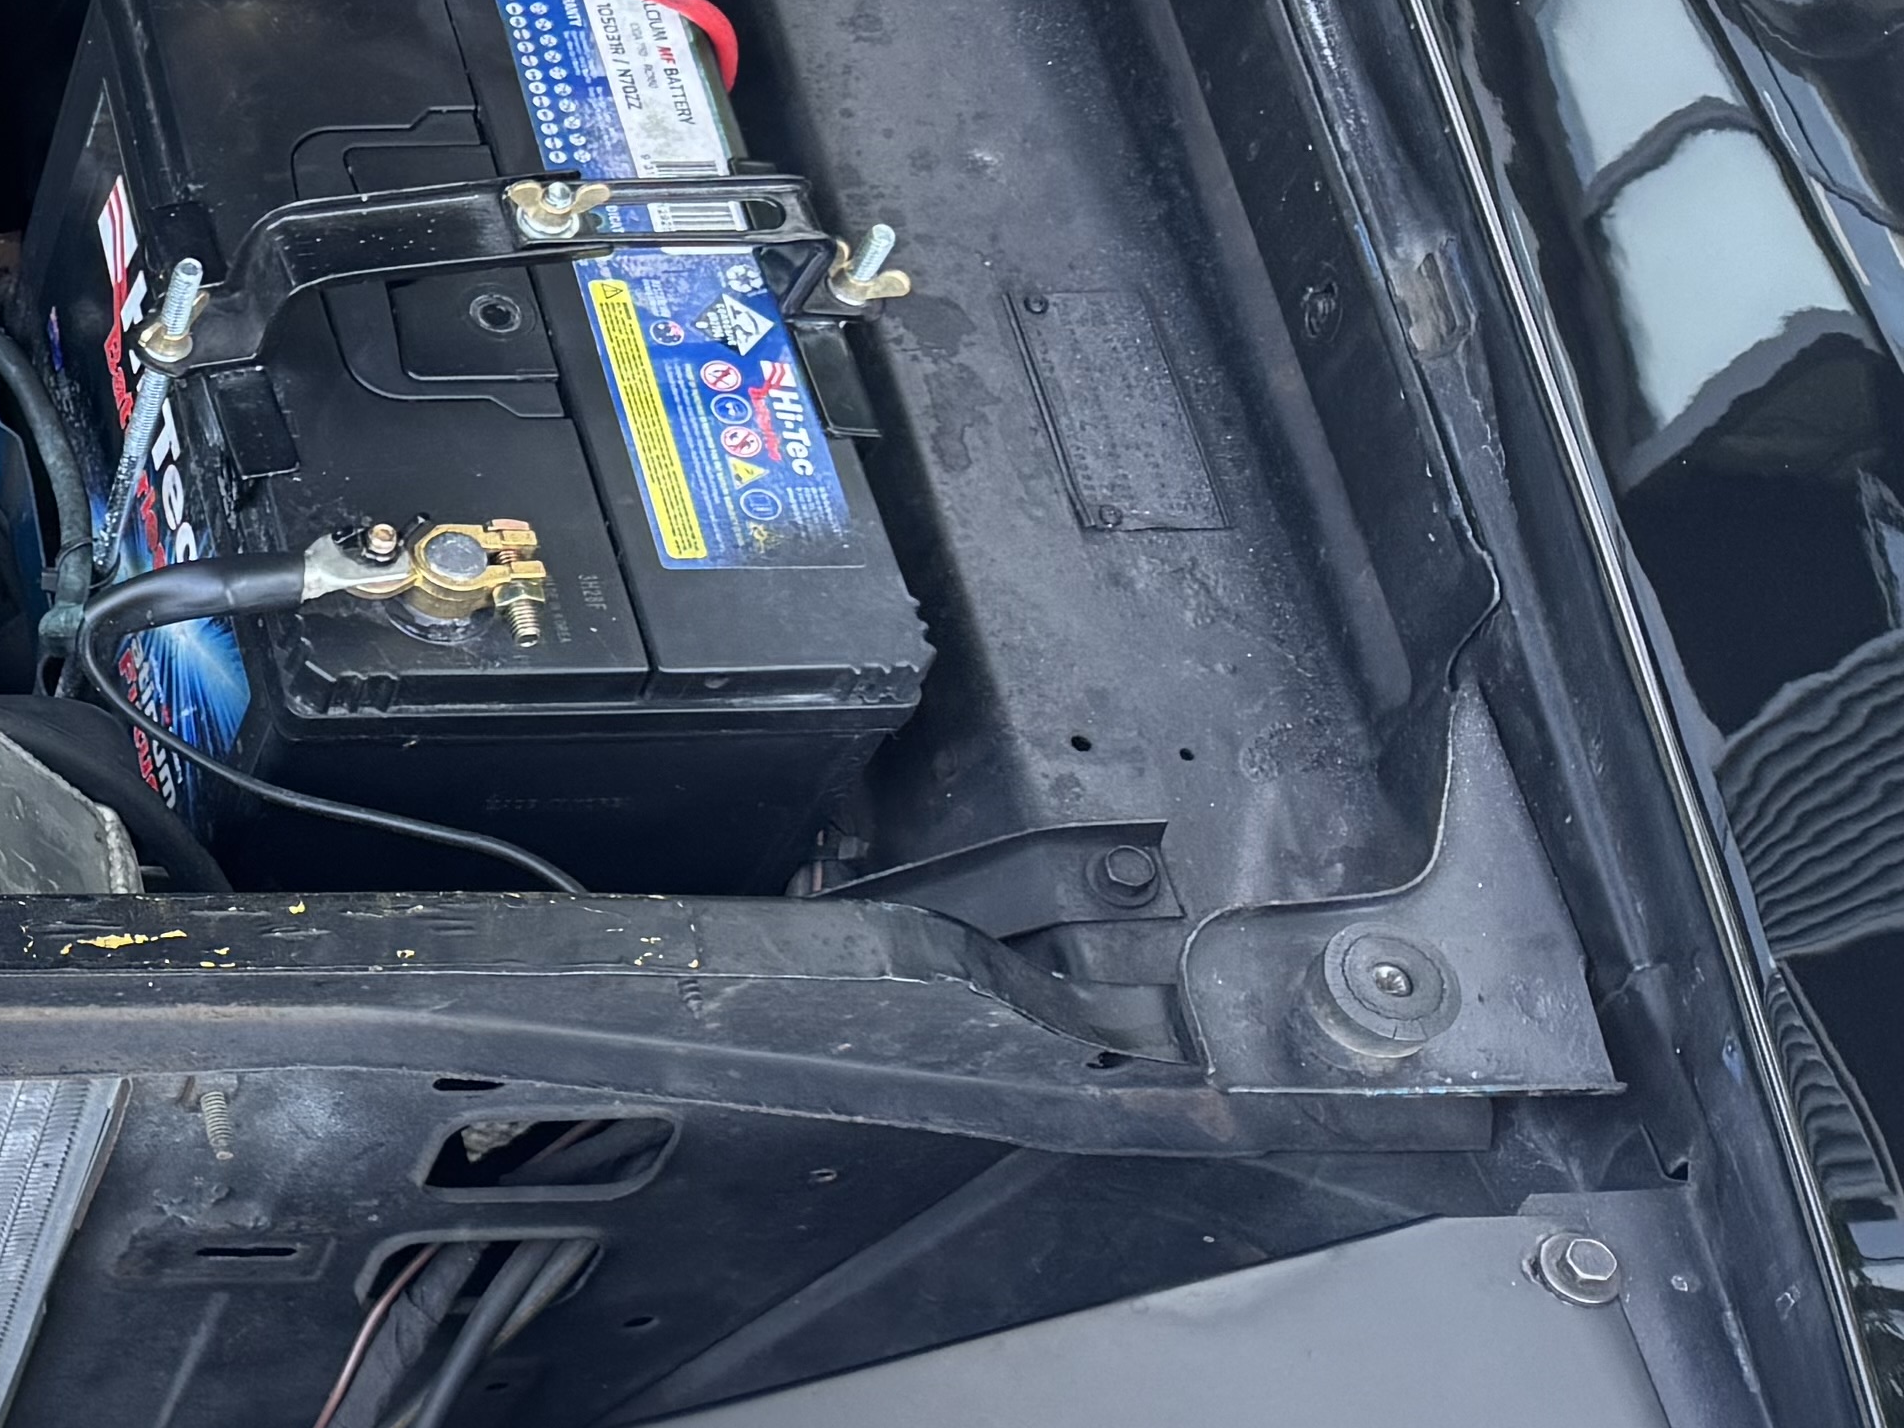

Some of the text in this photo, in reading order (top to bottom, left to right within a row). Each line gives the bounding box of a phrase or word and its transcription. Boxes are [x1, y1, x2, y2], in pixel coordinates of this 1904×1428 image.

[616, 67, 643, 111] N70ZZ
[663, 66, 697, 126] BATTERY
[768, 387, 815, 477] Hi-Tec
